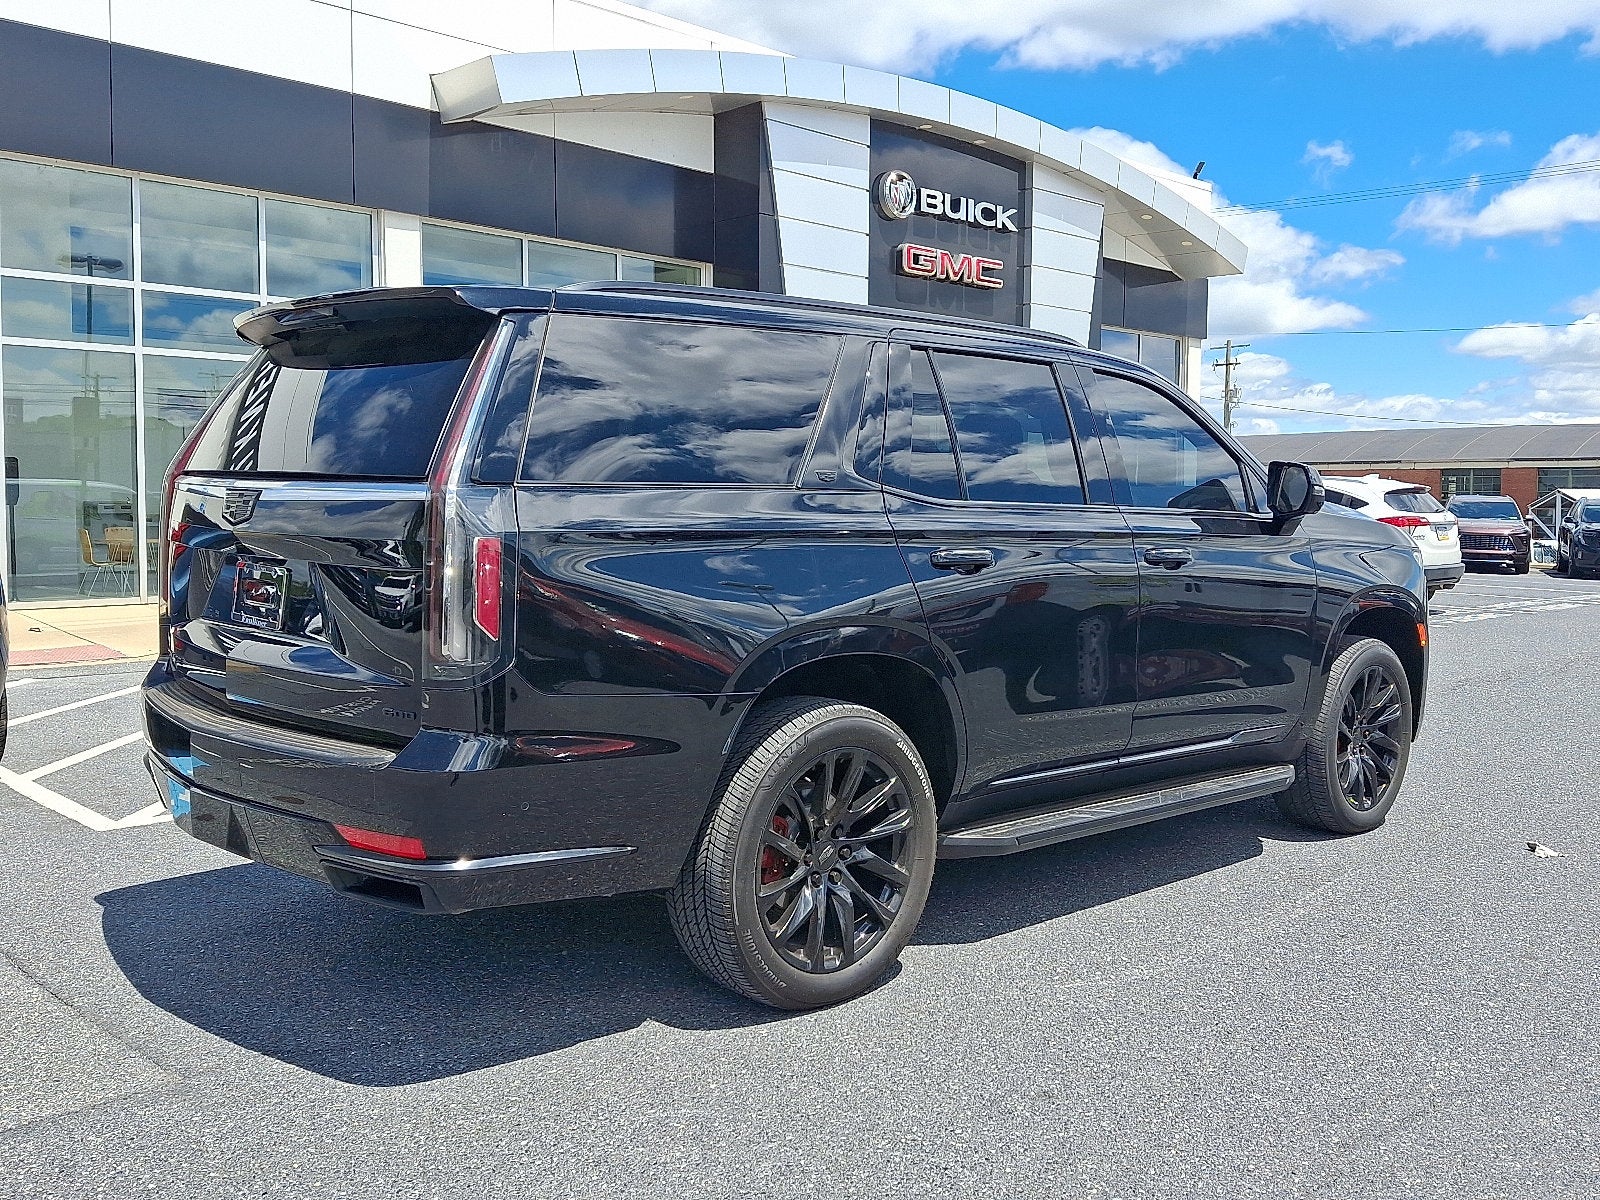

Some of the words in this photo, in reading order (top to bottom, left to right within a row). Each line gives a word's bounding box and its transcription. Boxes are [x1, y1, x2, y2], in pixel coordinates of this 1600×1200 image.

[920, 187, 1019, 232] BUICK
[901, 243, 1004, 289] GMC
[896, 738, 931, 800] BRIDGESTONE
